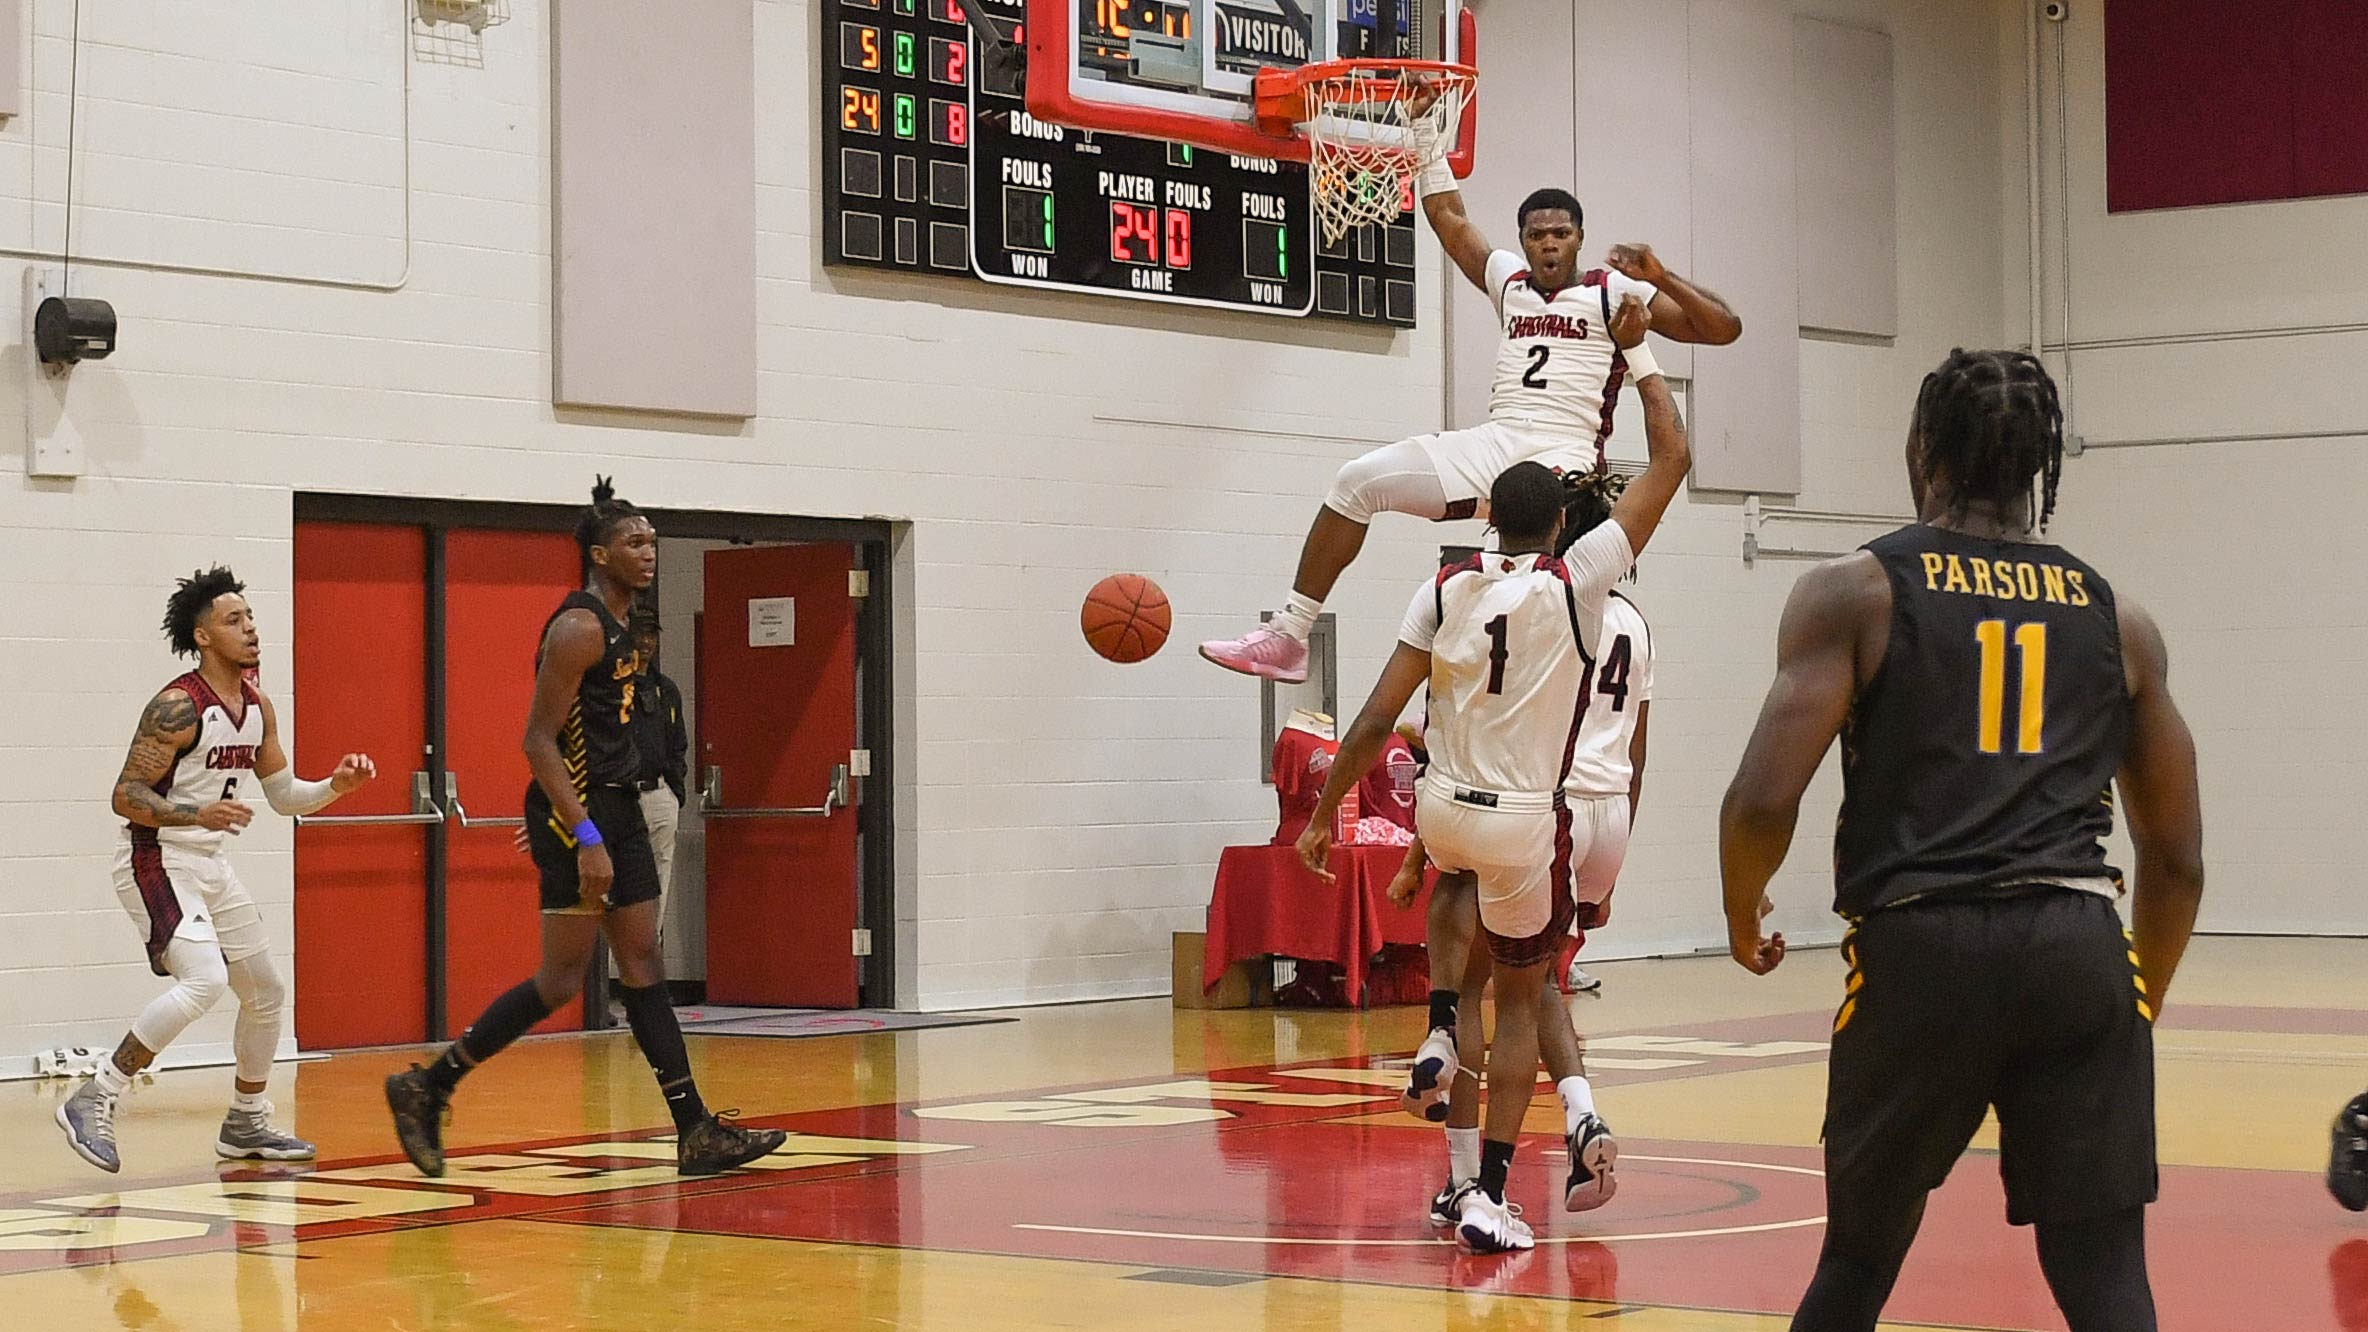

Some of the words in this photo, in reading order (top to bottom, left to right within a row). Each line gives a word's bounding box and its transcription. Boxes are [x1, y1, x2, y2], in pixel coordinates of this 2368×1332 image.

[861, 28, 877, 68] 5
[897, 35, 913, 74] 0
[948, 42, 965, 83] 2
[1231, 16, 1305, 60] VISITOR
[844, 87, 879, 130] 24
[897, 97, 913, 136] 0
[948, 104, 966, 145] 8
[1010, 110, 1064, 142] BONUS
[1002, 157, 1053, 188] FOULS
[1099, 171, 1155, 202] PLAYER
[1165, 181, 1212, 211] FOULS
[1043, 194, 1053, 248] 1
[1242, 192, 1286, 220] FOULS
[1112, 203, 1157, 261] 24
[1167, 210, 1189, 267] 0
[1277, 227, 1287, 277] 1
[1011, 253, 1049, 278] WON
[1131, 268, 1173, 292] GAME
[1251, 281, 1284, 305] WON
[1508, 313, 1589, 340] CARDINALS
[1522, 344, 1551, 390] 2
[1920, 551, 2091, 608] PARSONS
[1483, 613, 1510, 696] 1
[1597, 633, 1632, 713] 4
[1975, 619, 2048, 754] 11
[205, 744, 262, 770] CARDINAL
